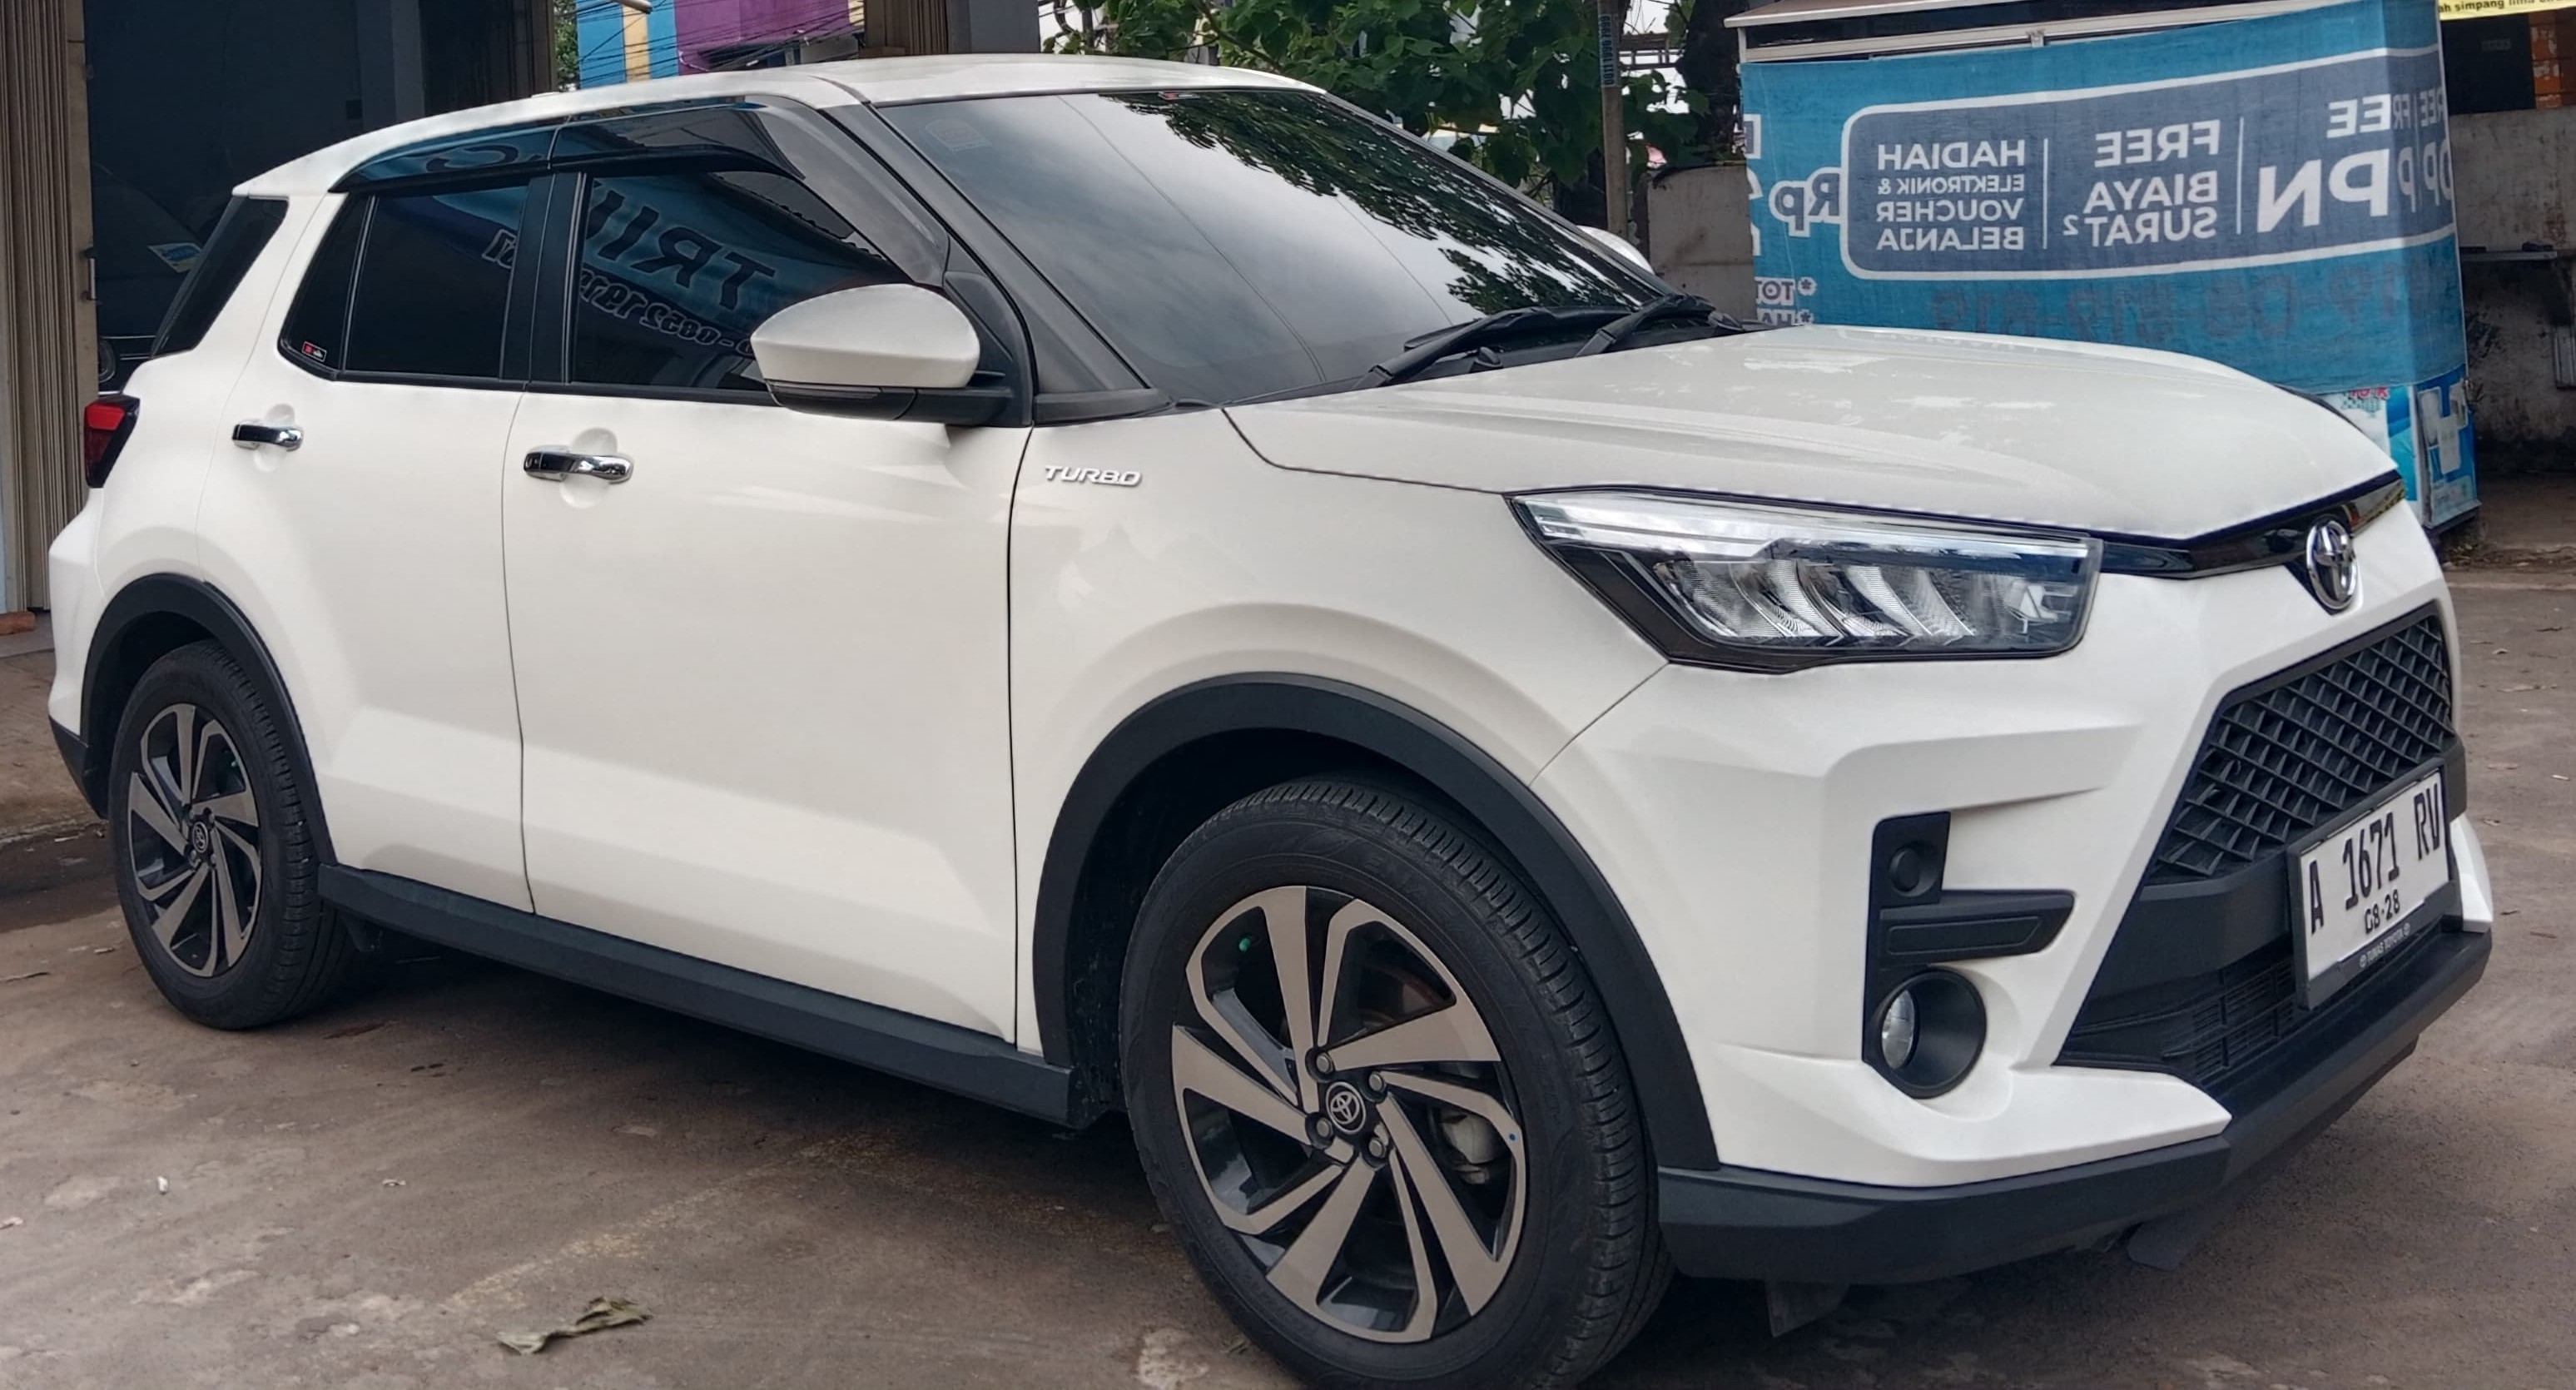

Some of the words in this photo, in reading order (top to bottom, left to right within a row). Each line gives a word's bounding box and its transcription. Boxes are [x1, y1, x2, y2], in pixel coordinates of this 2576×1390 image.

[2438, 4, 2451, 12] ah
[2454, 1, 2504, 12] simpang
[1045, 464, 1142, 487] TURBO
[2309, 860, 2324, 935] A
[2342, 812, 2400, 911] 1671
[2413, 783, 2440, 861] RV
